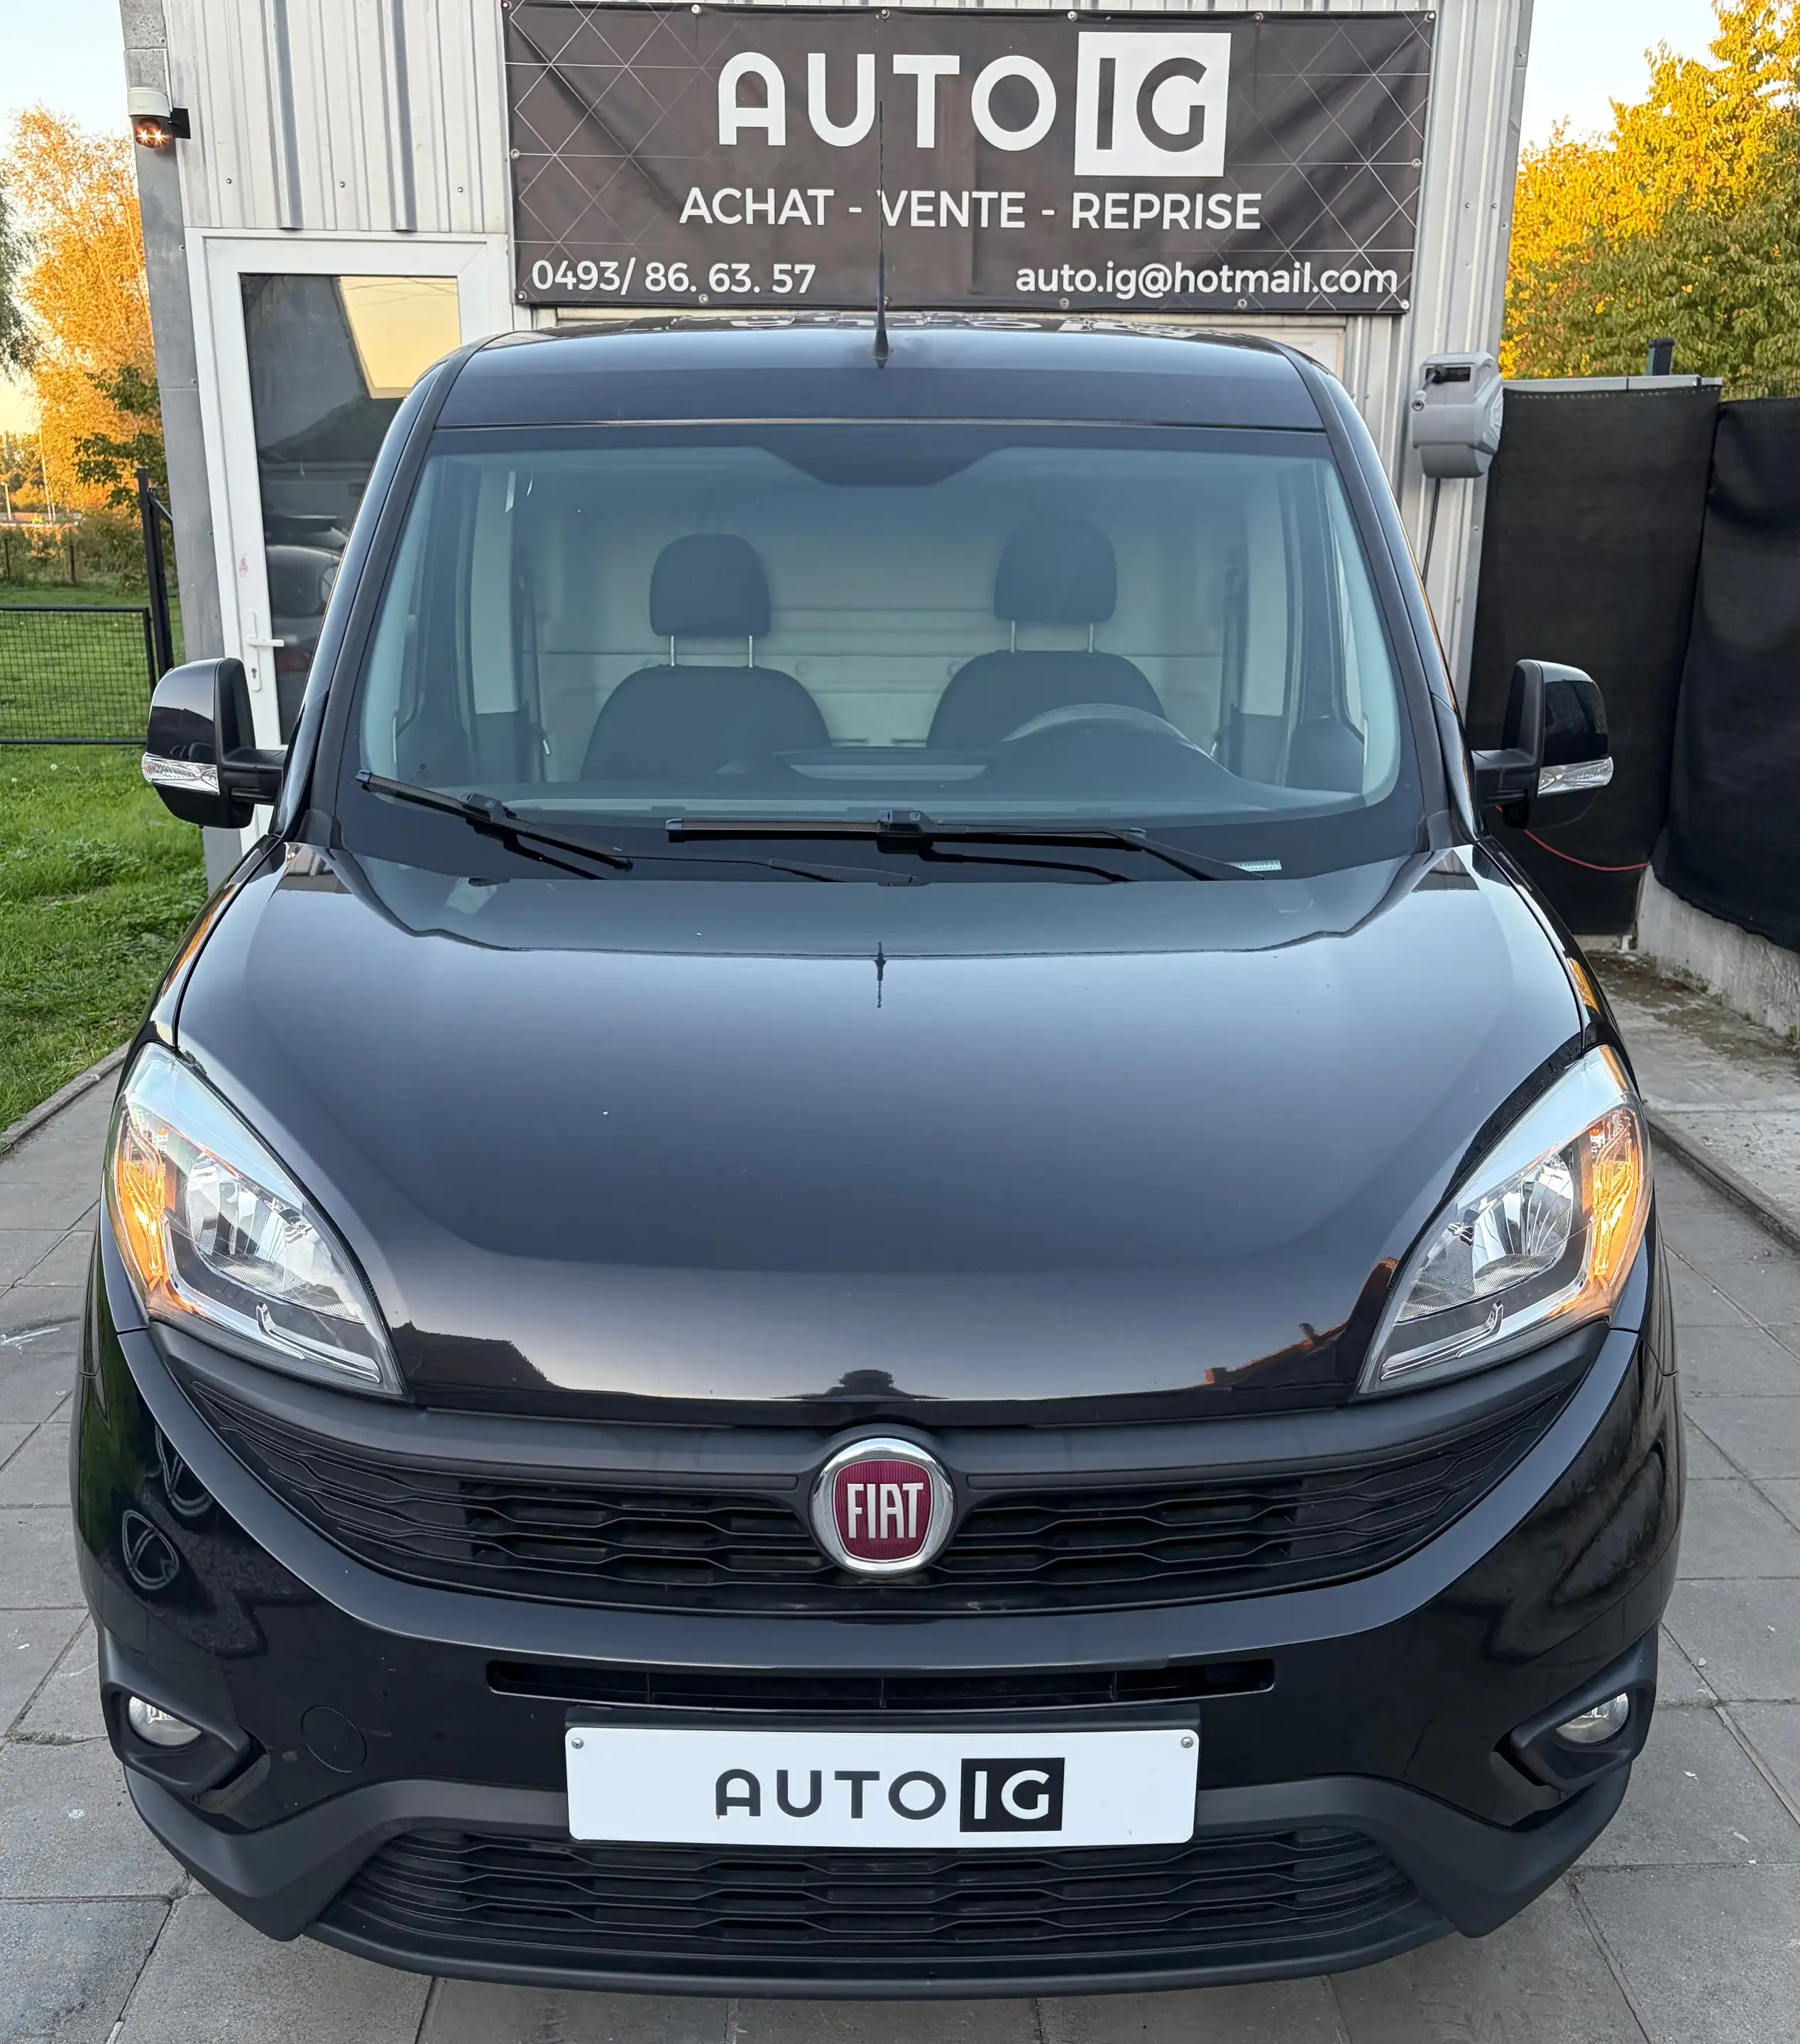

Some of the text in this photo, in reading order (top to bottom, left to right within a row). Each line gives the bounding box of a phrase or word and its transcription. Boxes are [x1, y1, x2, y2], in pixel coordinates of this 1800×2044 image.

[718, 52, 1207, 152] AUTO IG
[679, 187, 834, 225] ACHAT
[876, 190, 1026, 228] VENTE
[1072, 192, 1261, 229] REPRISE
[532, 257, 816, 295] 0493/ 86. 63. 57
[1016, 260, 1398, 300] auto.ig@hotmail.com
[847, 1483, 923, 1539] FIAT
[715, 1769, 1049, 1820] AUTO IG
